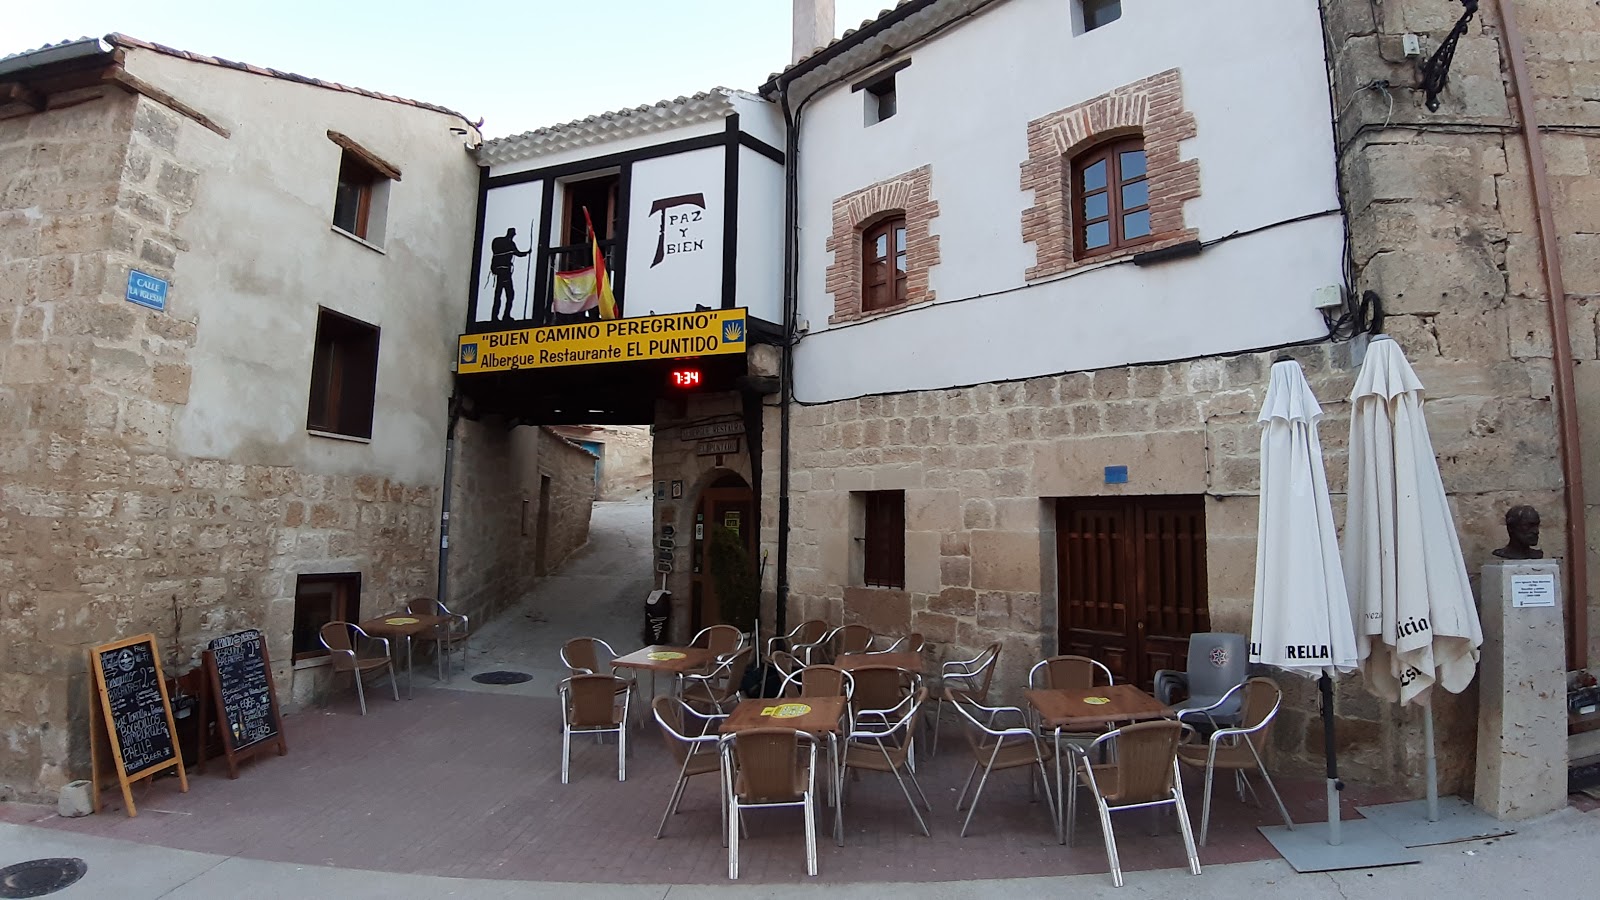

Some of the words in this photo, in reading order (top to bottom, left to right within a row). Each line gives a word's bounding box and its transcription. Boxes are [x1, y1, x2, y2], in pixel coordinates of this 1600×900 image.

[669, 210, 702, 226] PAZ
[679, 227, 689, 237] Y
[667, 239, 704, 254] BIEN
[136, 278, 160, 293] CALLE
[129, 287, 138, 296] LA
[139, 289, 163, 304] IGLESIA
[482, 331, 529, 349] "BUEN
[535, 325, 600, 343] CAMINO
[606, 313, 718, 337] PEREGRINO"
[480, 353, 535, 370] Albergue
[539, 344, 622, 364] Restaurante
[627, 341, 643, 357] EL
[649, 335, 719, 355] PUNTIDO
[673, 371, 699, 385] 7:34
[1285, 645, 1329, 659] RELLA
